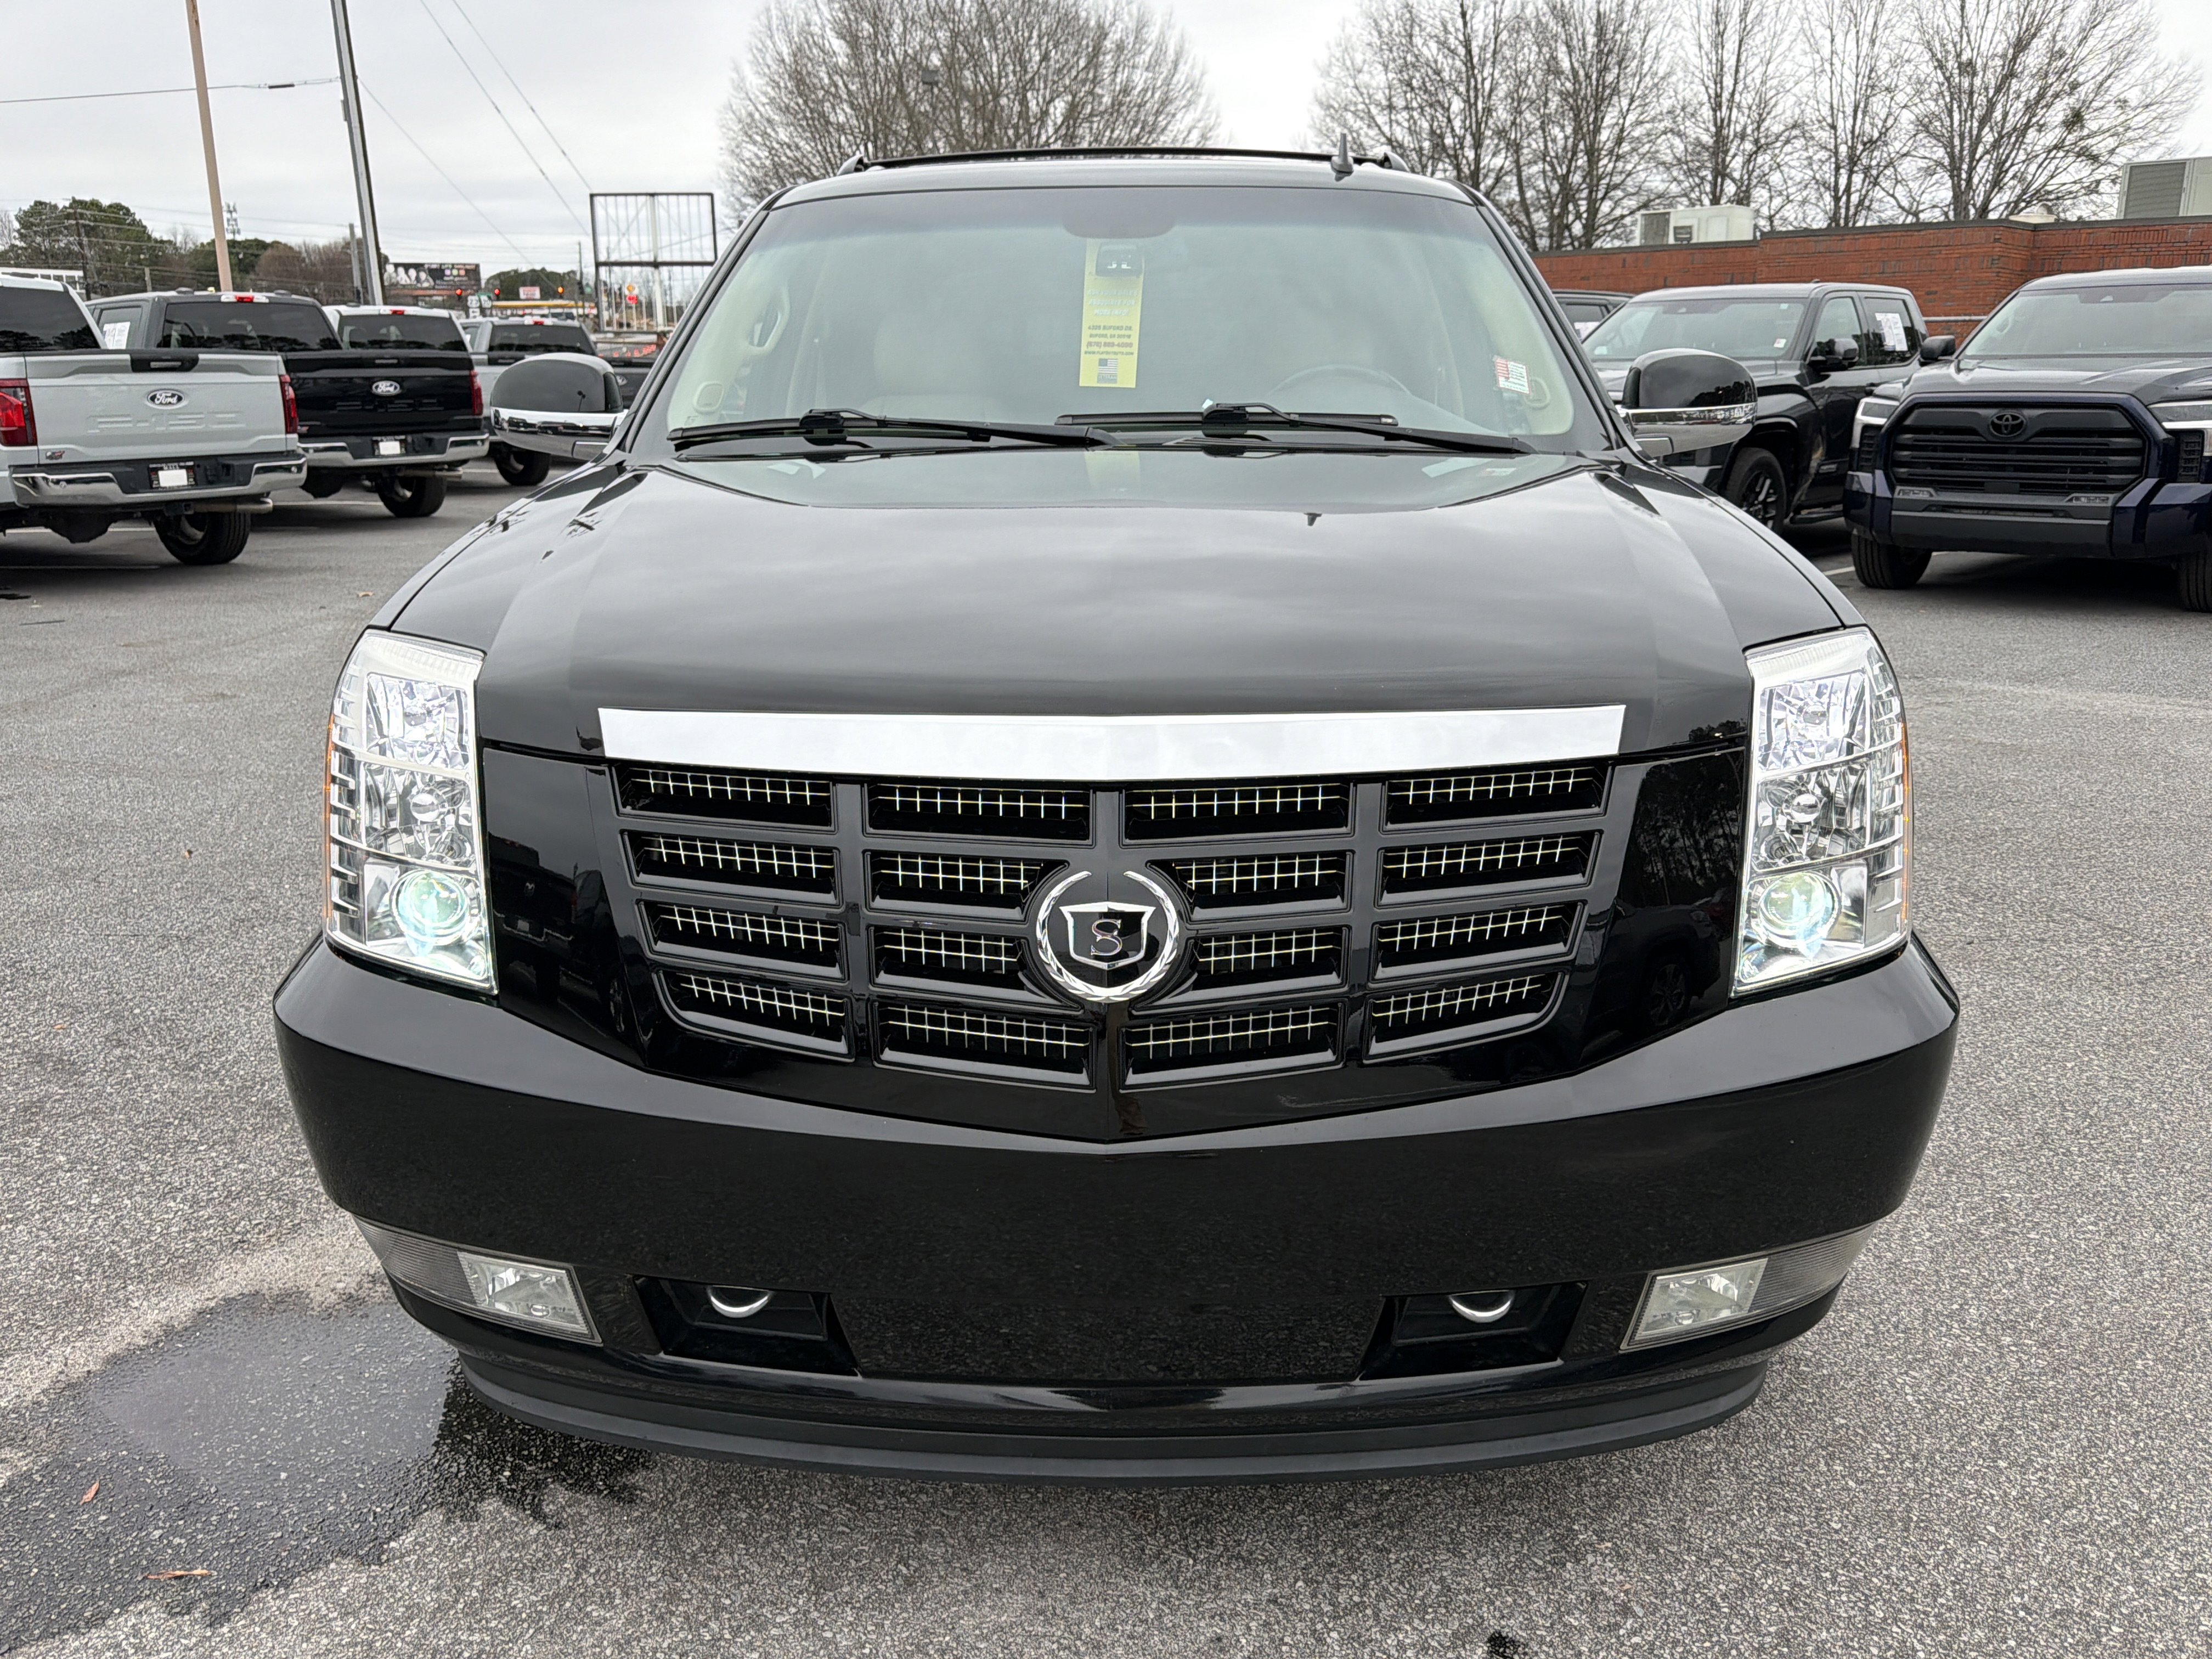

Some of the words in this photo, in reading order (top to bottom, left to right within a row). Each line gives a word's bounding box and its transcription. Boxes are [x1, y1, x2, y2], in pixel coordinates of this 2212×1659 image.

[377, 383, 395, 392] Ford
[155, 392, 178, 404] Ford
[1091, 918, 1122, 956] S
